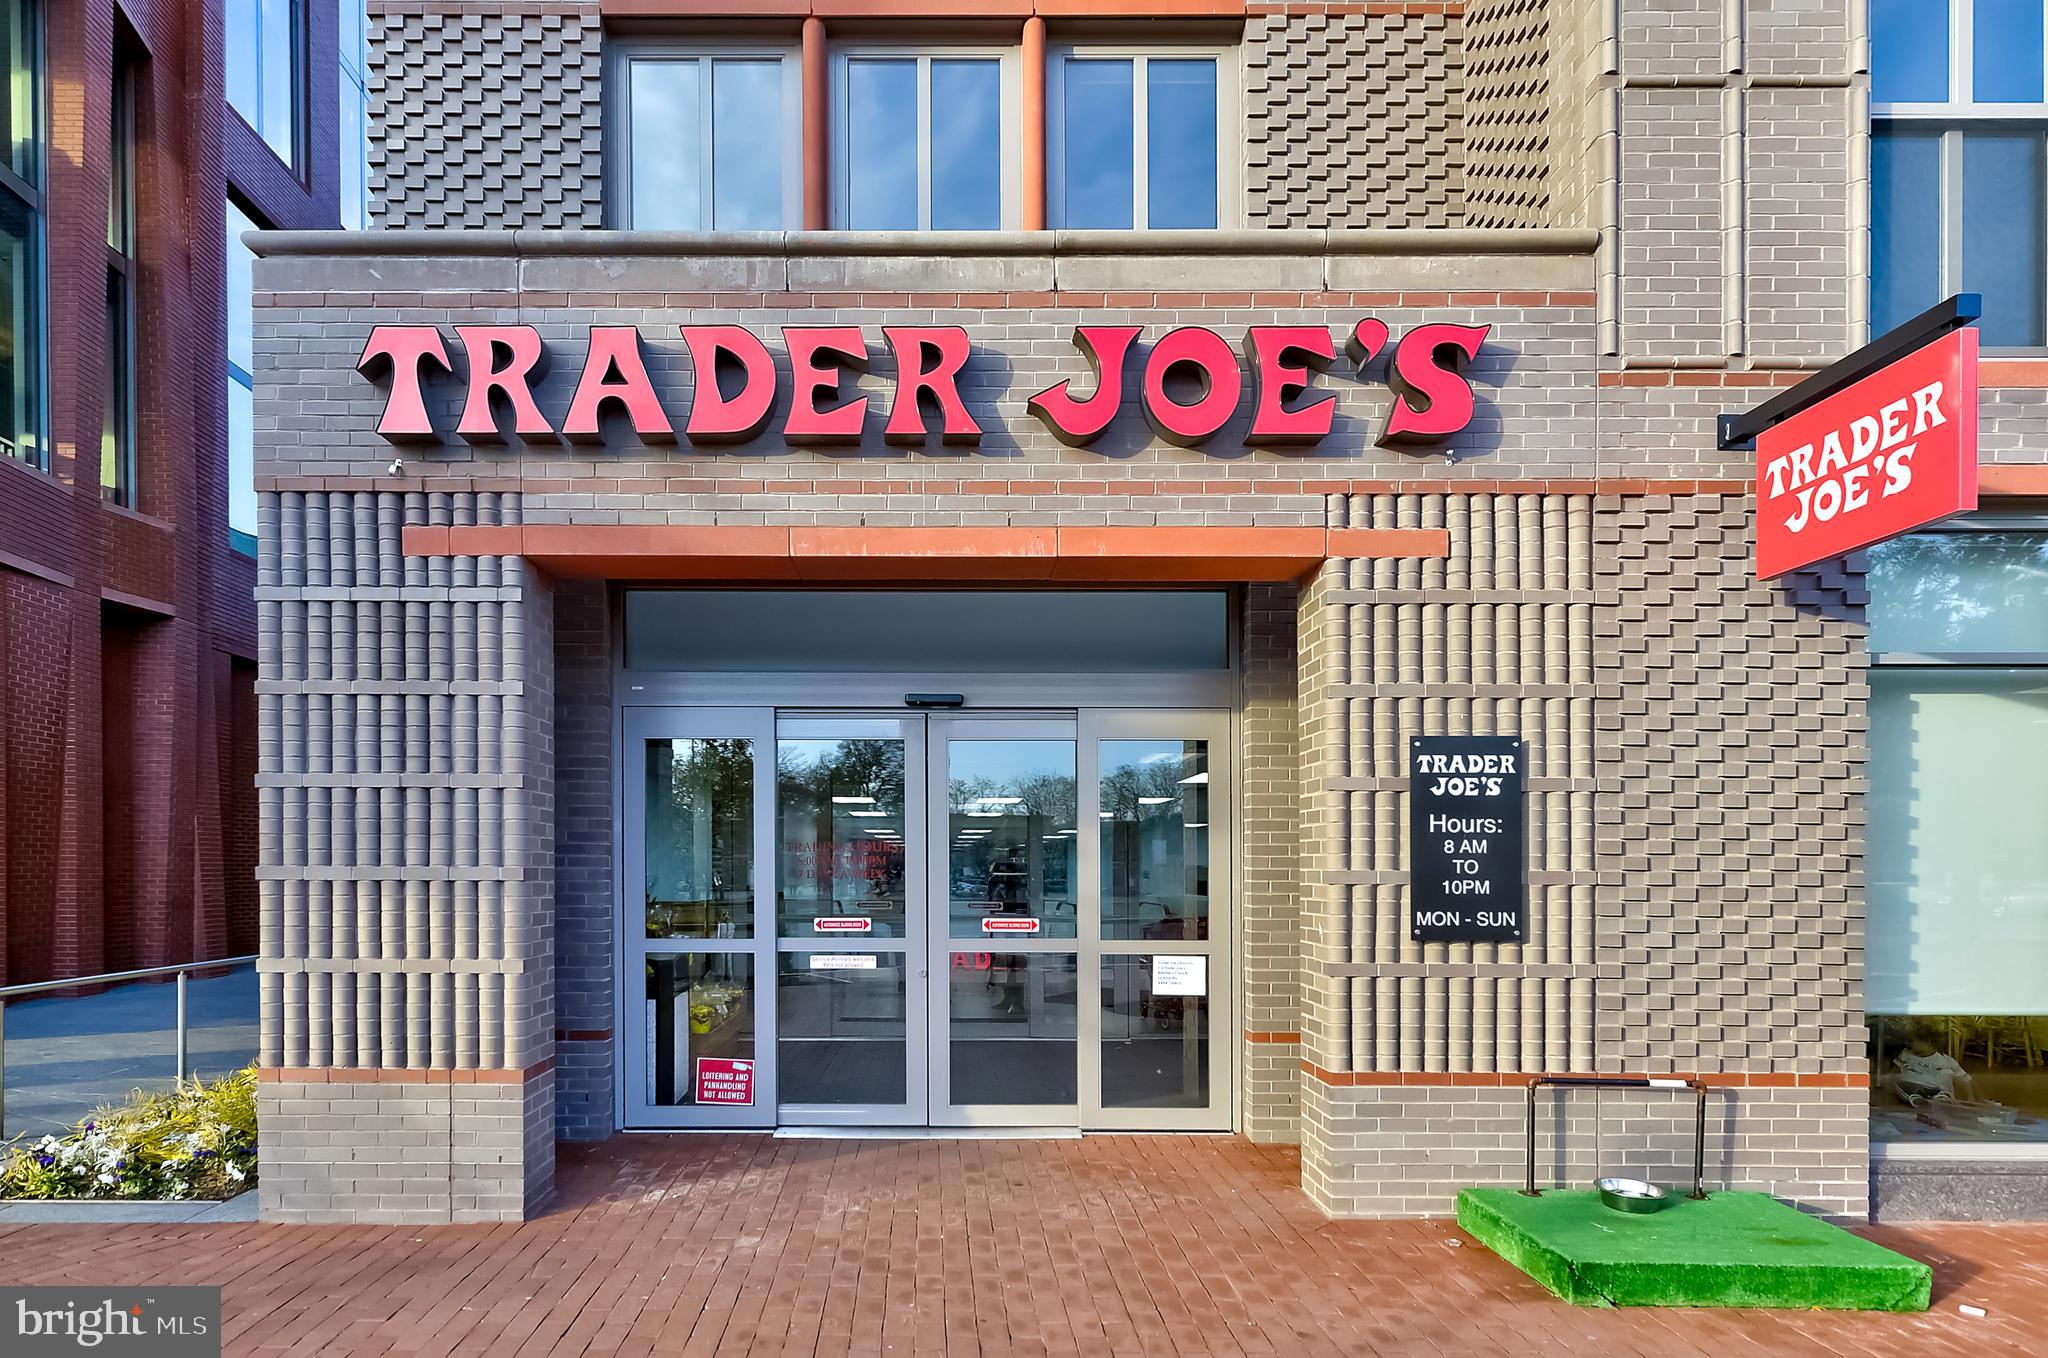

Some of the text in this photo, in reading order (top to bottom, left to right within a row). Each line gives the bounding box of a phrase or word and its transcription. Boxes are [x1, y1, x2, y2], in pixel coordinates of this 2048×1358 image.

[357, 317, 1492, 441] TRADER JOE'S
[1765, 381, 1948, 500] TRADER
[1784, 442, 1918, 533] JOE'S
[1416, 754, 1516, 774] TRADER
[1429, 777, 1503, 796] JOE'S
[1429, 814, 1503, 833] Hours:
[1443, 840, 1487, 854] 8 AM
[1452, 859, 1479, 875] TO
[1442, 880, 1490, 895] 10PM
[1416, 911, 1460, 927] MON
[1476, 911, 1516, 927] SUN
[702, 1072, 749, 1081] LOITERING AND
[704, 1081, 746, 1091] PANHANDLING
[704, 1090, 746, 1100] NOT ALLOWED
